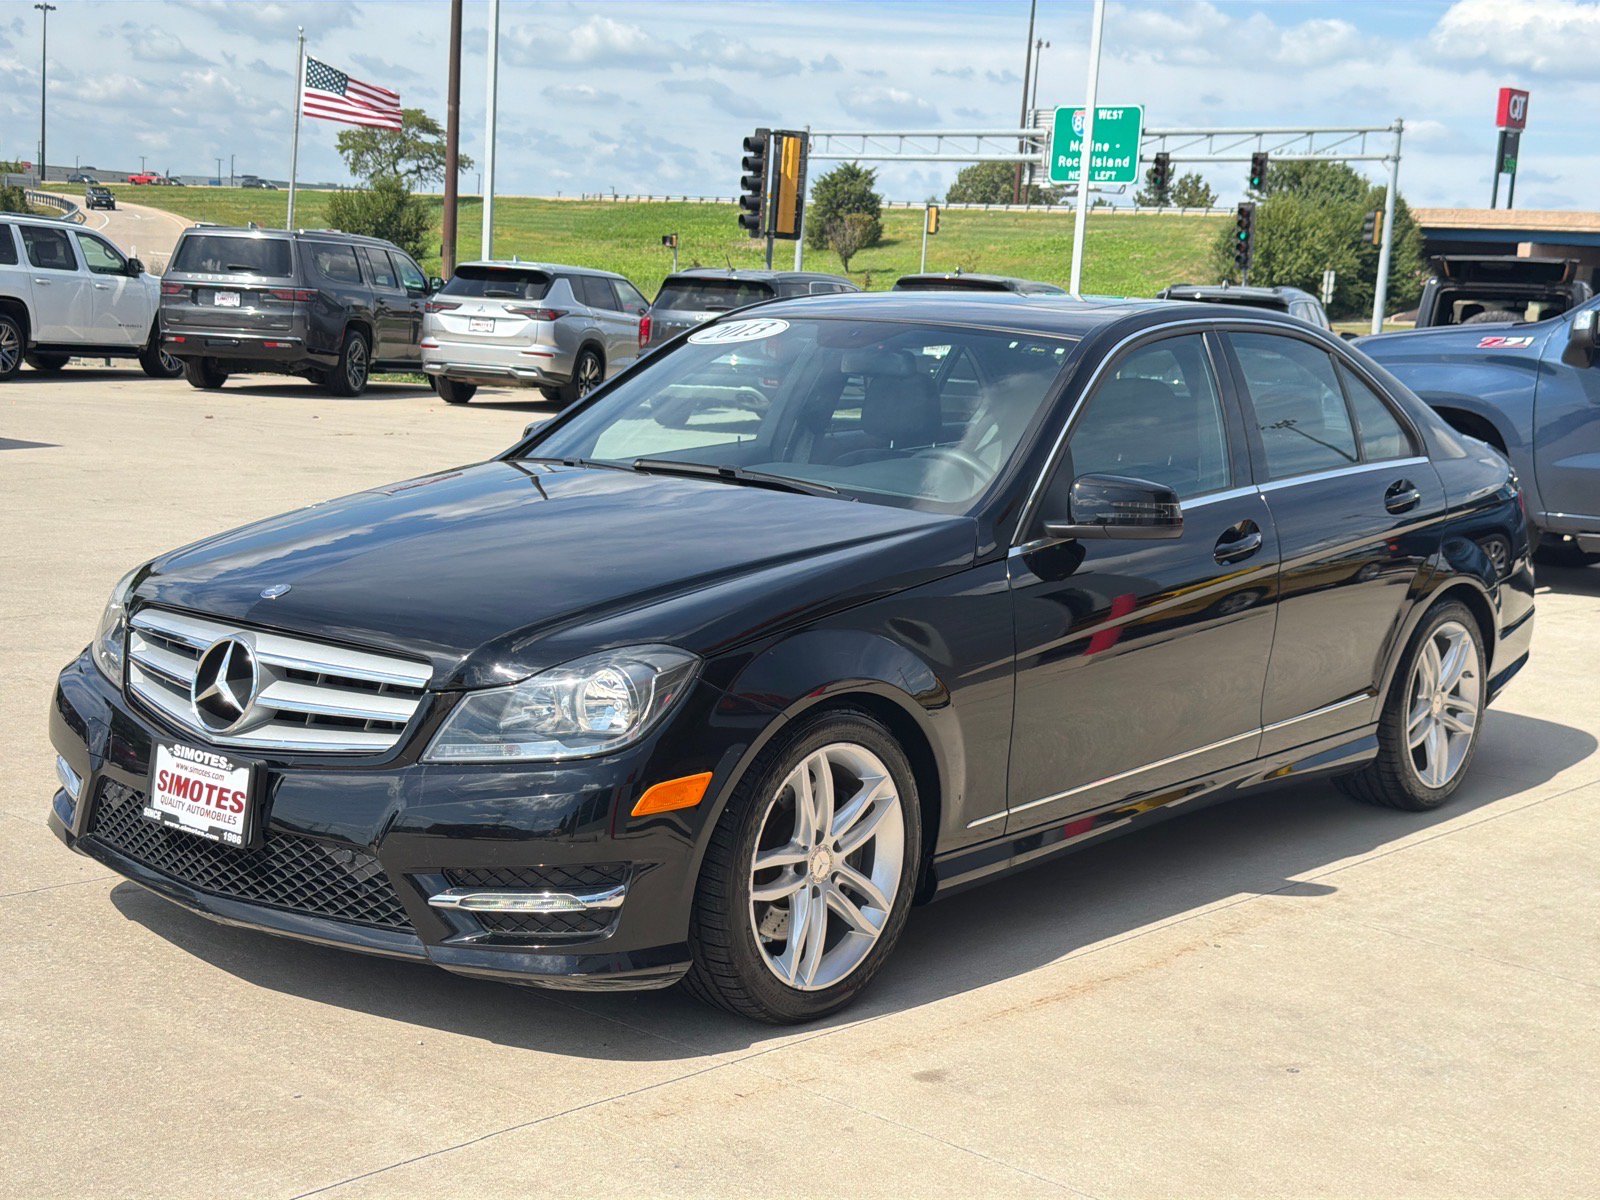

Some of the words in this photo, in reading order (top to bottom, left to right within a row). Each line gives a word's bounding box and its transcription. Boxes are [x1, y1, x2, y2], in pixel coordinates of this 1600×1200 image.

[1098, 109, 1123, 120] WEST
[1509, 94, 1526, 122] QT
[1058, 155, 1081, 168] Roc
[1091, 155, 1130, 168] Island
[1094, 170, 1117, 180] LEFT
[698, 321, 777, 340] 2013
[1476, 336, 1535, 349] Z71
[173, 743, 228, 770] SIMOTES
[175, 761, 225, 781] www.simotes.com
[157, 769, 246, 814] SIMOTES
[160, 795, 185, 811] QUALITY
[186, 804, 237, 825] AUTOMOBILES
[143, 807, 162, 821] SINCE
[223, 831, 242, 845] 1986
